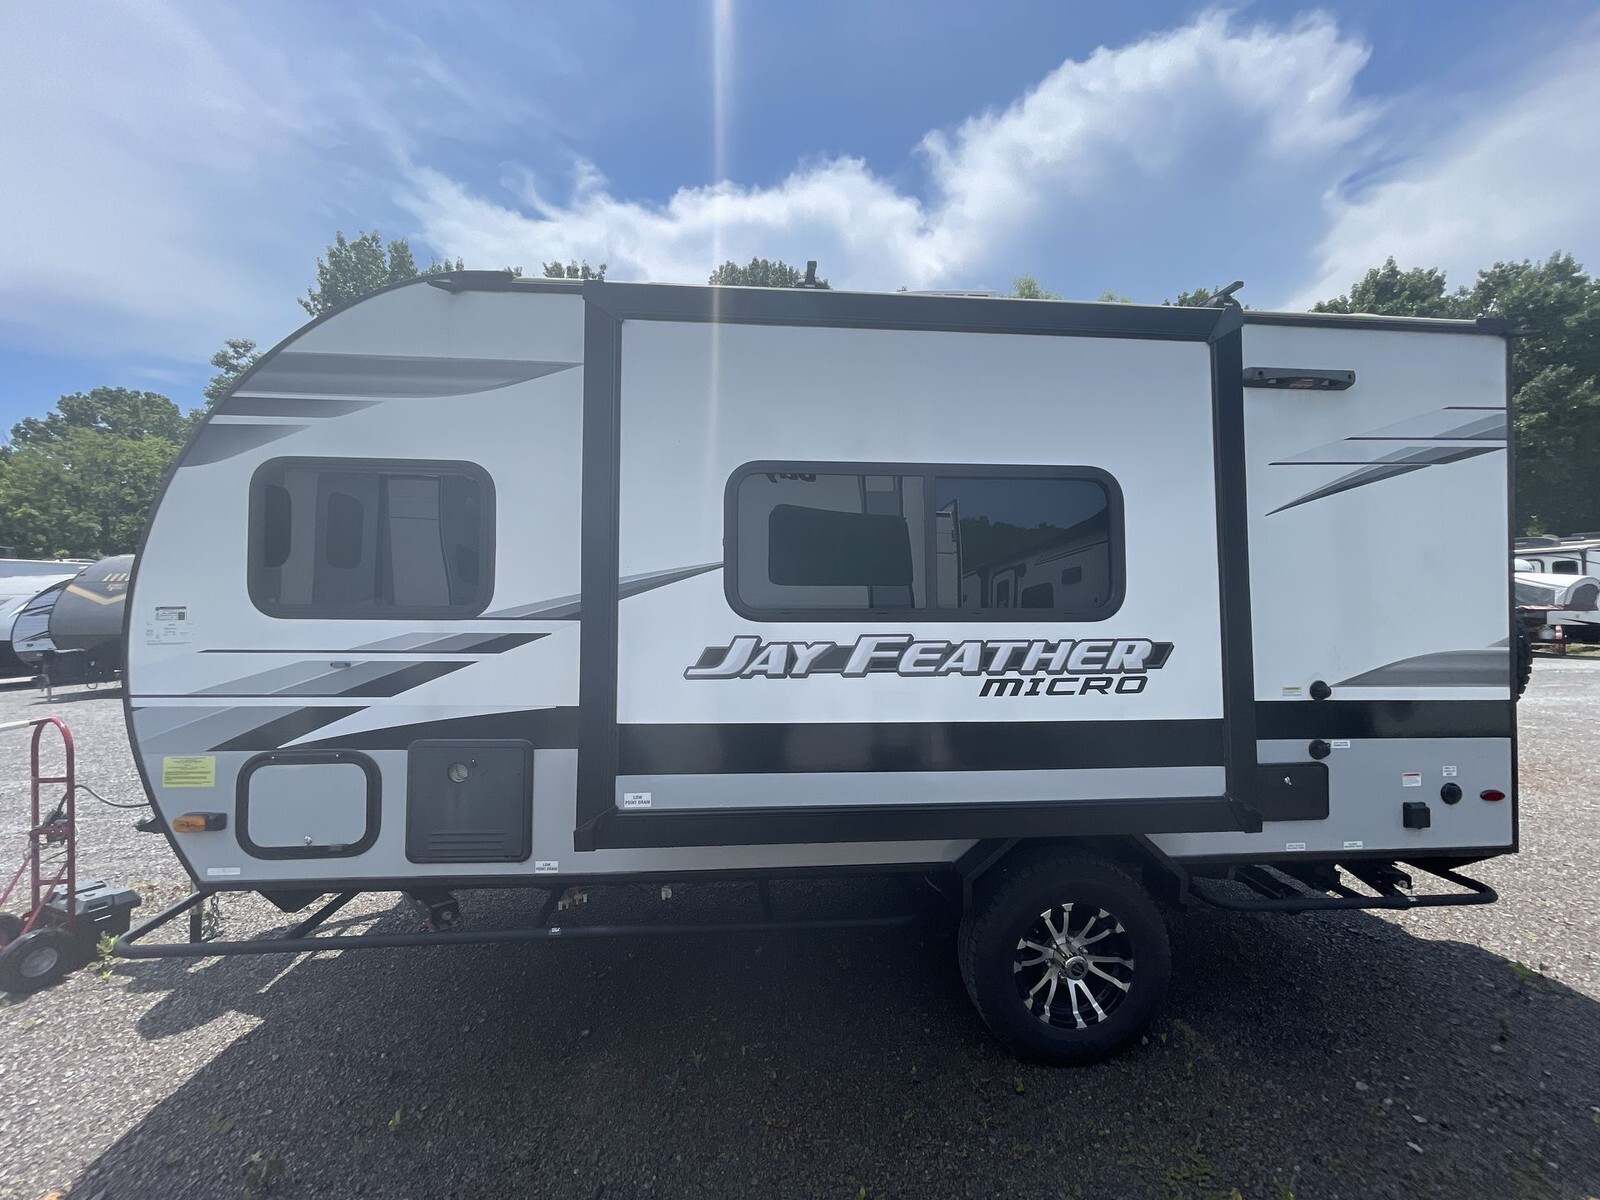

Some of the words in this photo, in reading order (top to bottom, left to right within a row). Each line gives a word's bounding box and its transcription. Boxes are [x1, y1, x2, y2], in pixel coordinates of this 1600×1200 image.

[683, 635, 836, 680] JAY
[842, 634, 1155, 678] FEATHER
[979, 676, 1149, 697] MICRO
